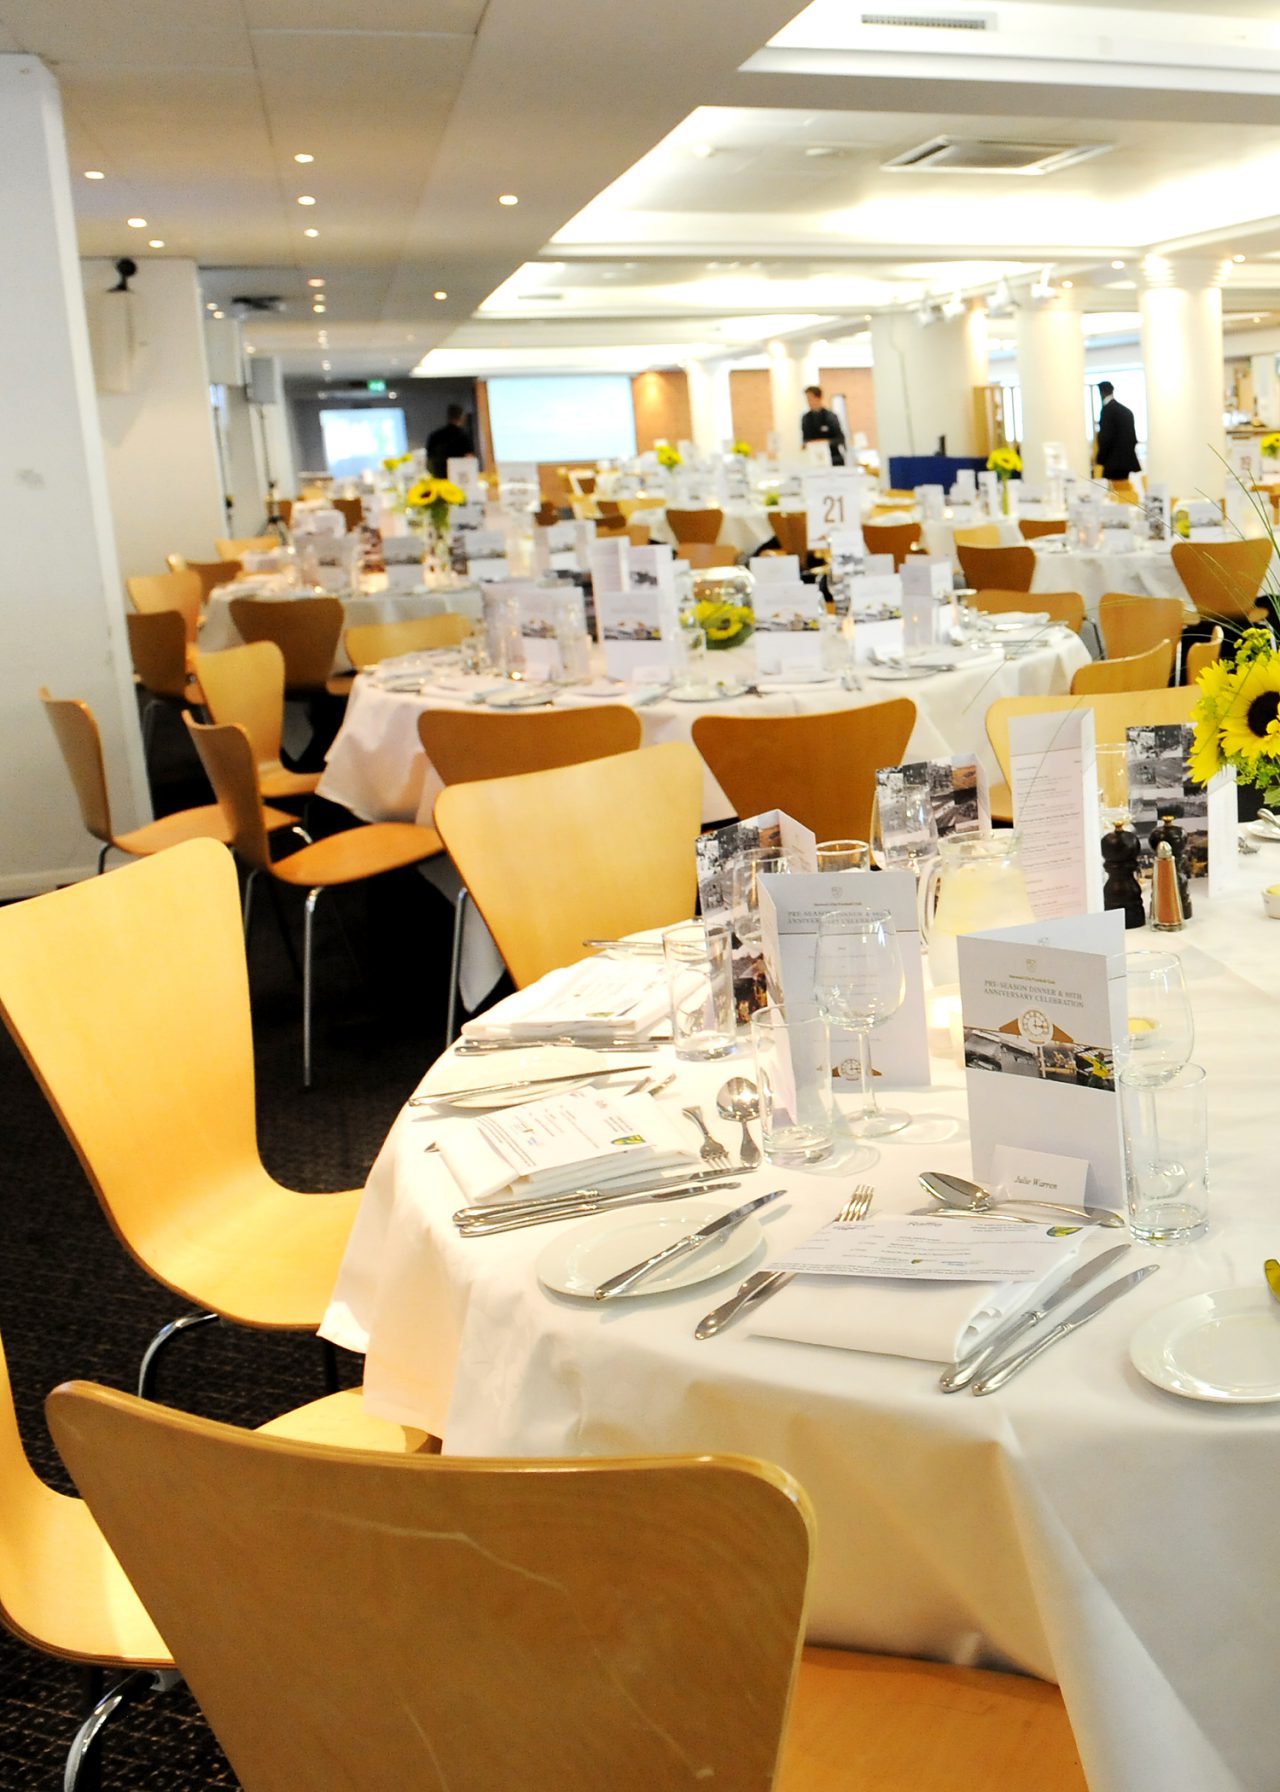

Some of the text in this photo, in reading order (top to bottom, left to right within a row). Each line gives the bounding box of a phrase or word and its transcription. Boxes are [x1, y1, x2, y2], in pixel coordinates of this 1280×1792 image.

[823, 495, 845, 523] 21
[984, 988, 1085, 1009] ANNIVERSARY CELEBRATION
[1028, 985, 1057, 997] DINNER
[1033, 1178, 1058, 1190] Warren
